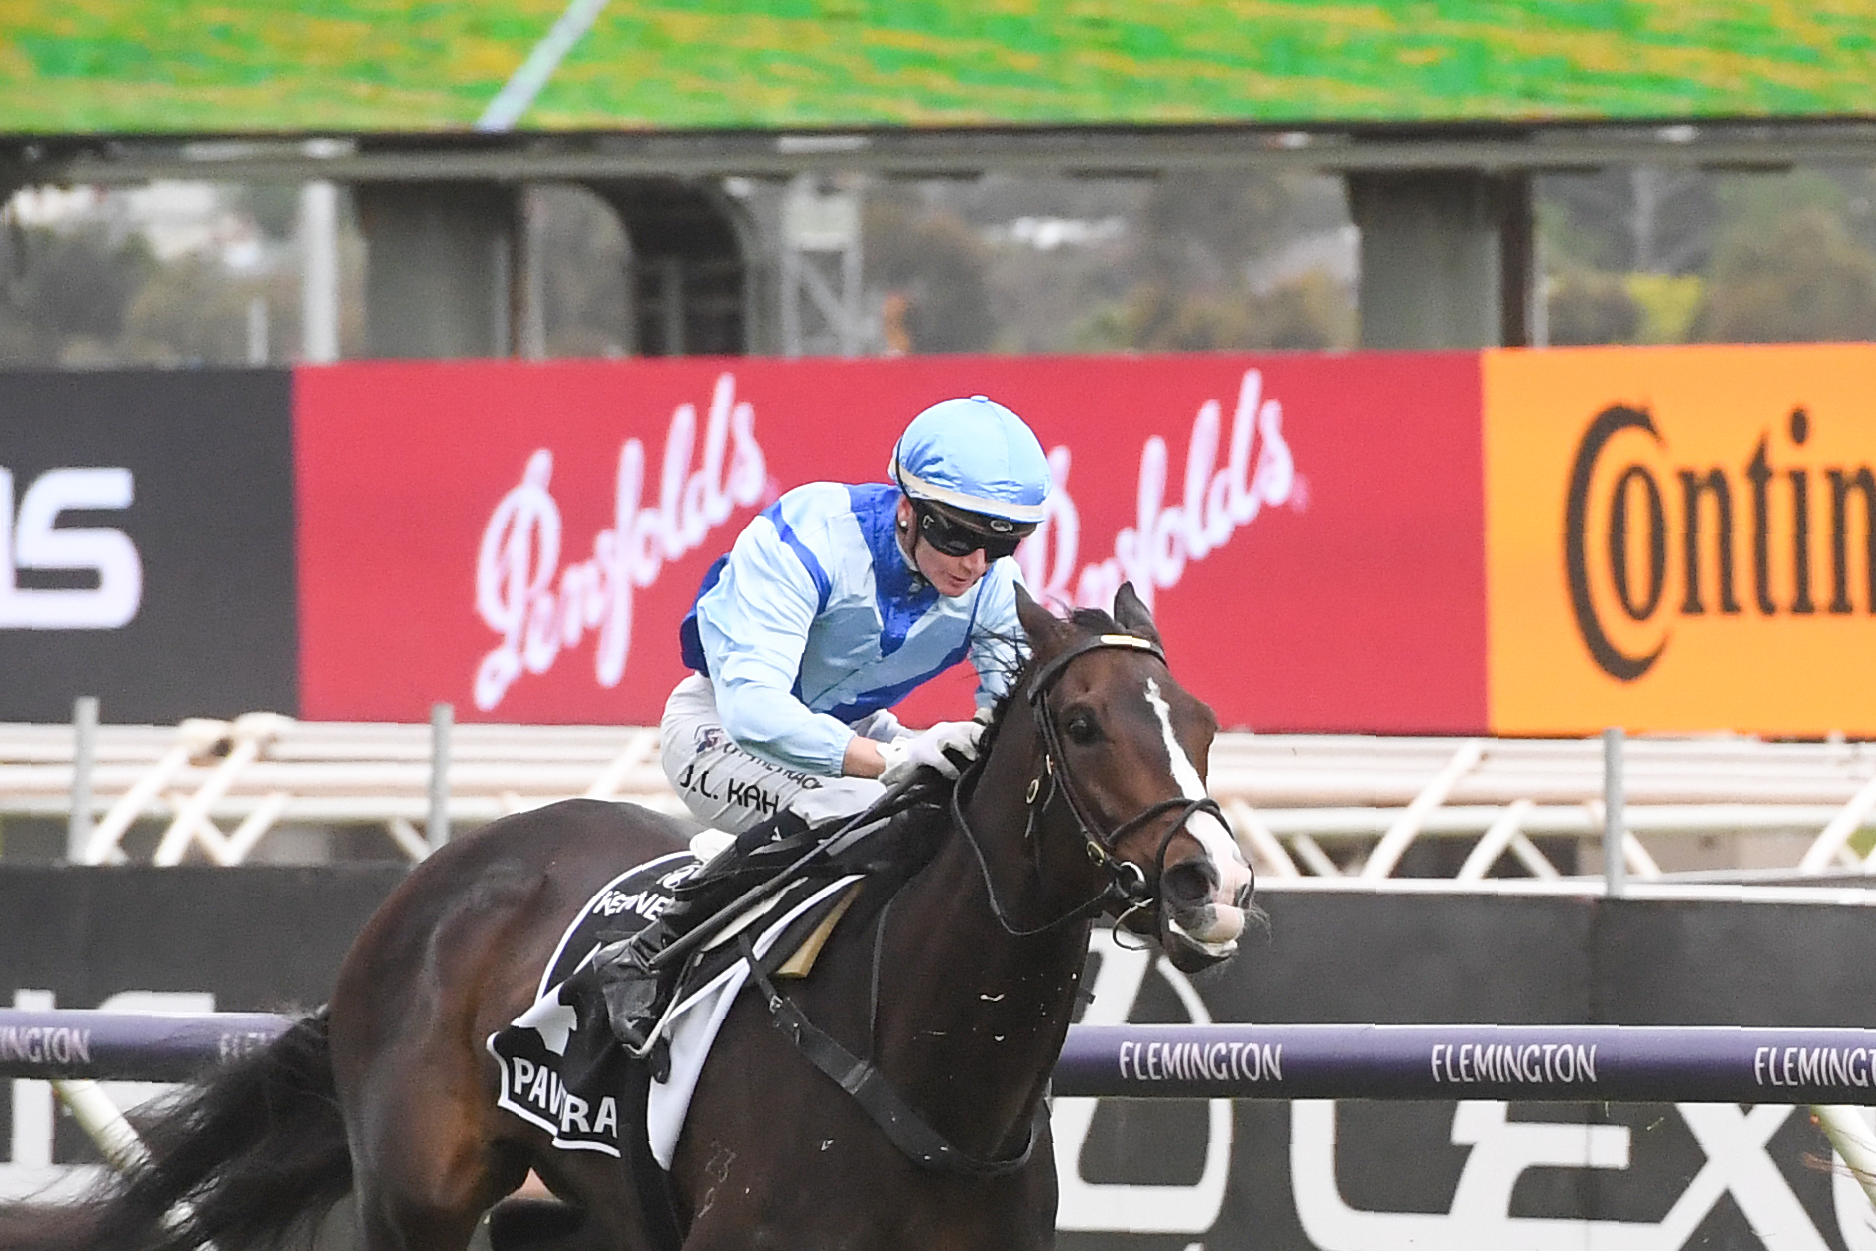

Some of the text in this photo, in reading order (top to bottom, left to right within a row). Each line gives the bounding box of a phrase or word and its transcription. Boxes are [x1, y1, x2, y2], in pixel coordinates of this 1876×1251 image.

[0, 465, 143, 630] S
[474, 371, 766, 711] Penfolds
[727, 778, 780, 814] KAH
[1119, 1041, 1283, 1082] FLEMINGTON
[1431, 1043, 1597, 1084] FLEMINGTON
